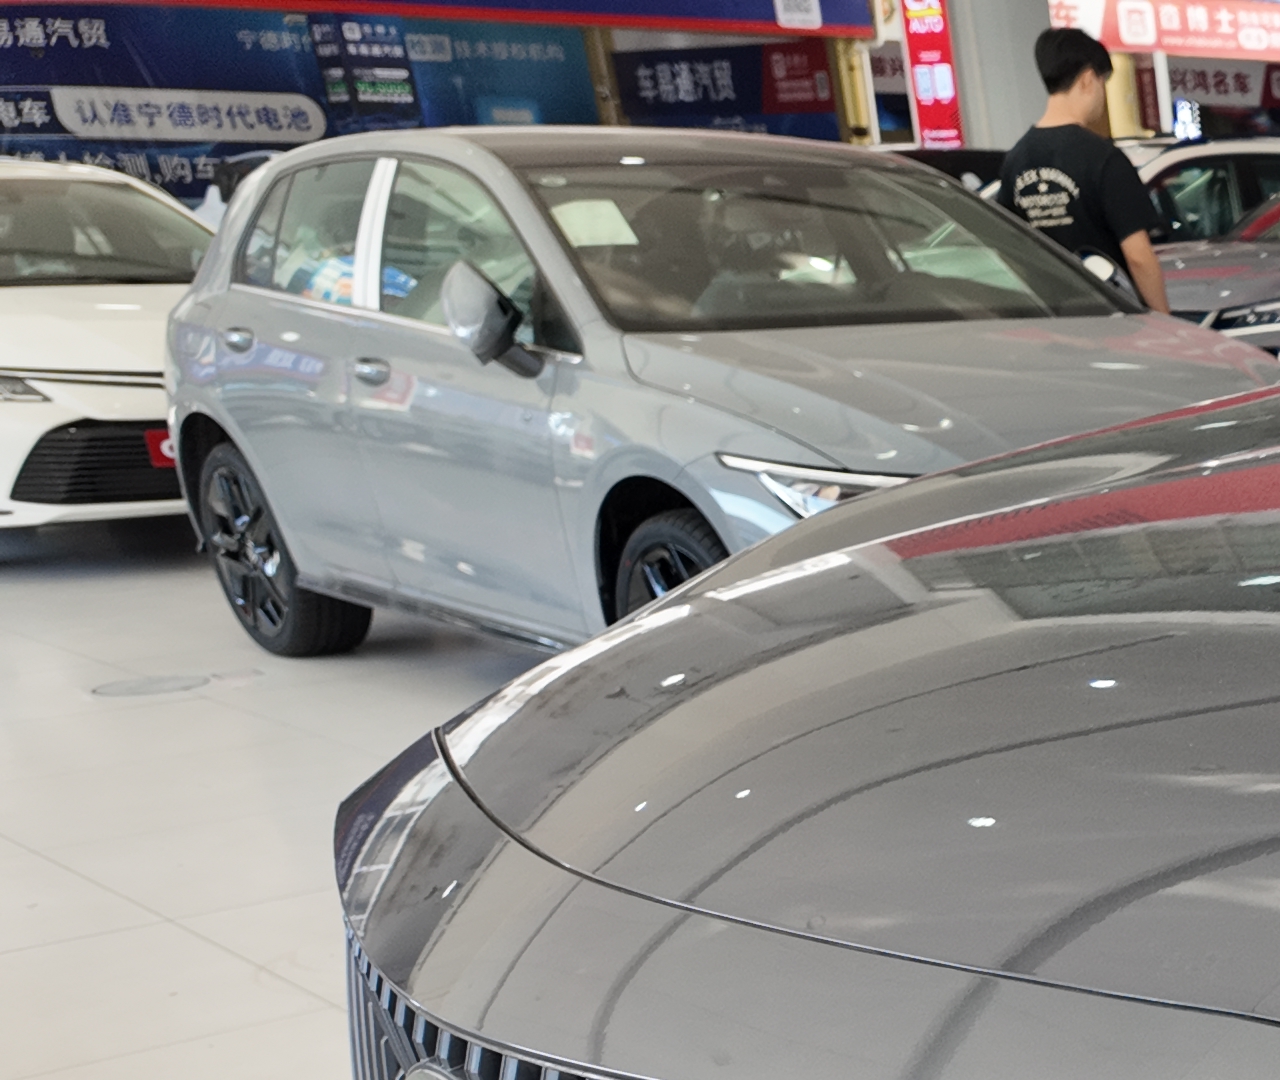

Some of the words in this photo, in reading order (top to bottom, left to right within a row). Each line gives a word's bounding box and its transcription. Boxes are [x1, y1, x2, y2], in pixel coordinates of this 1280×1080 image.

[75, 99, 312, 132] 认准宁德时代电池
